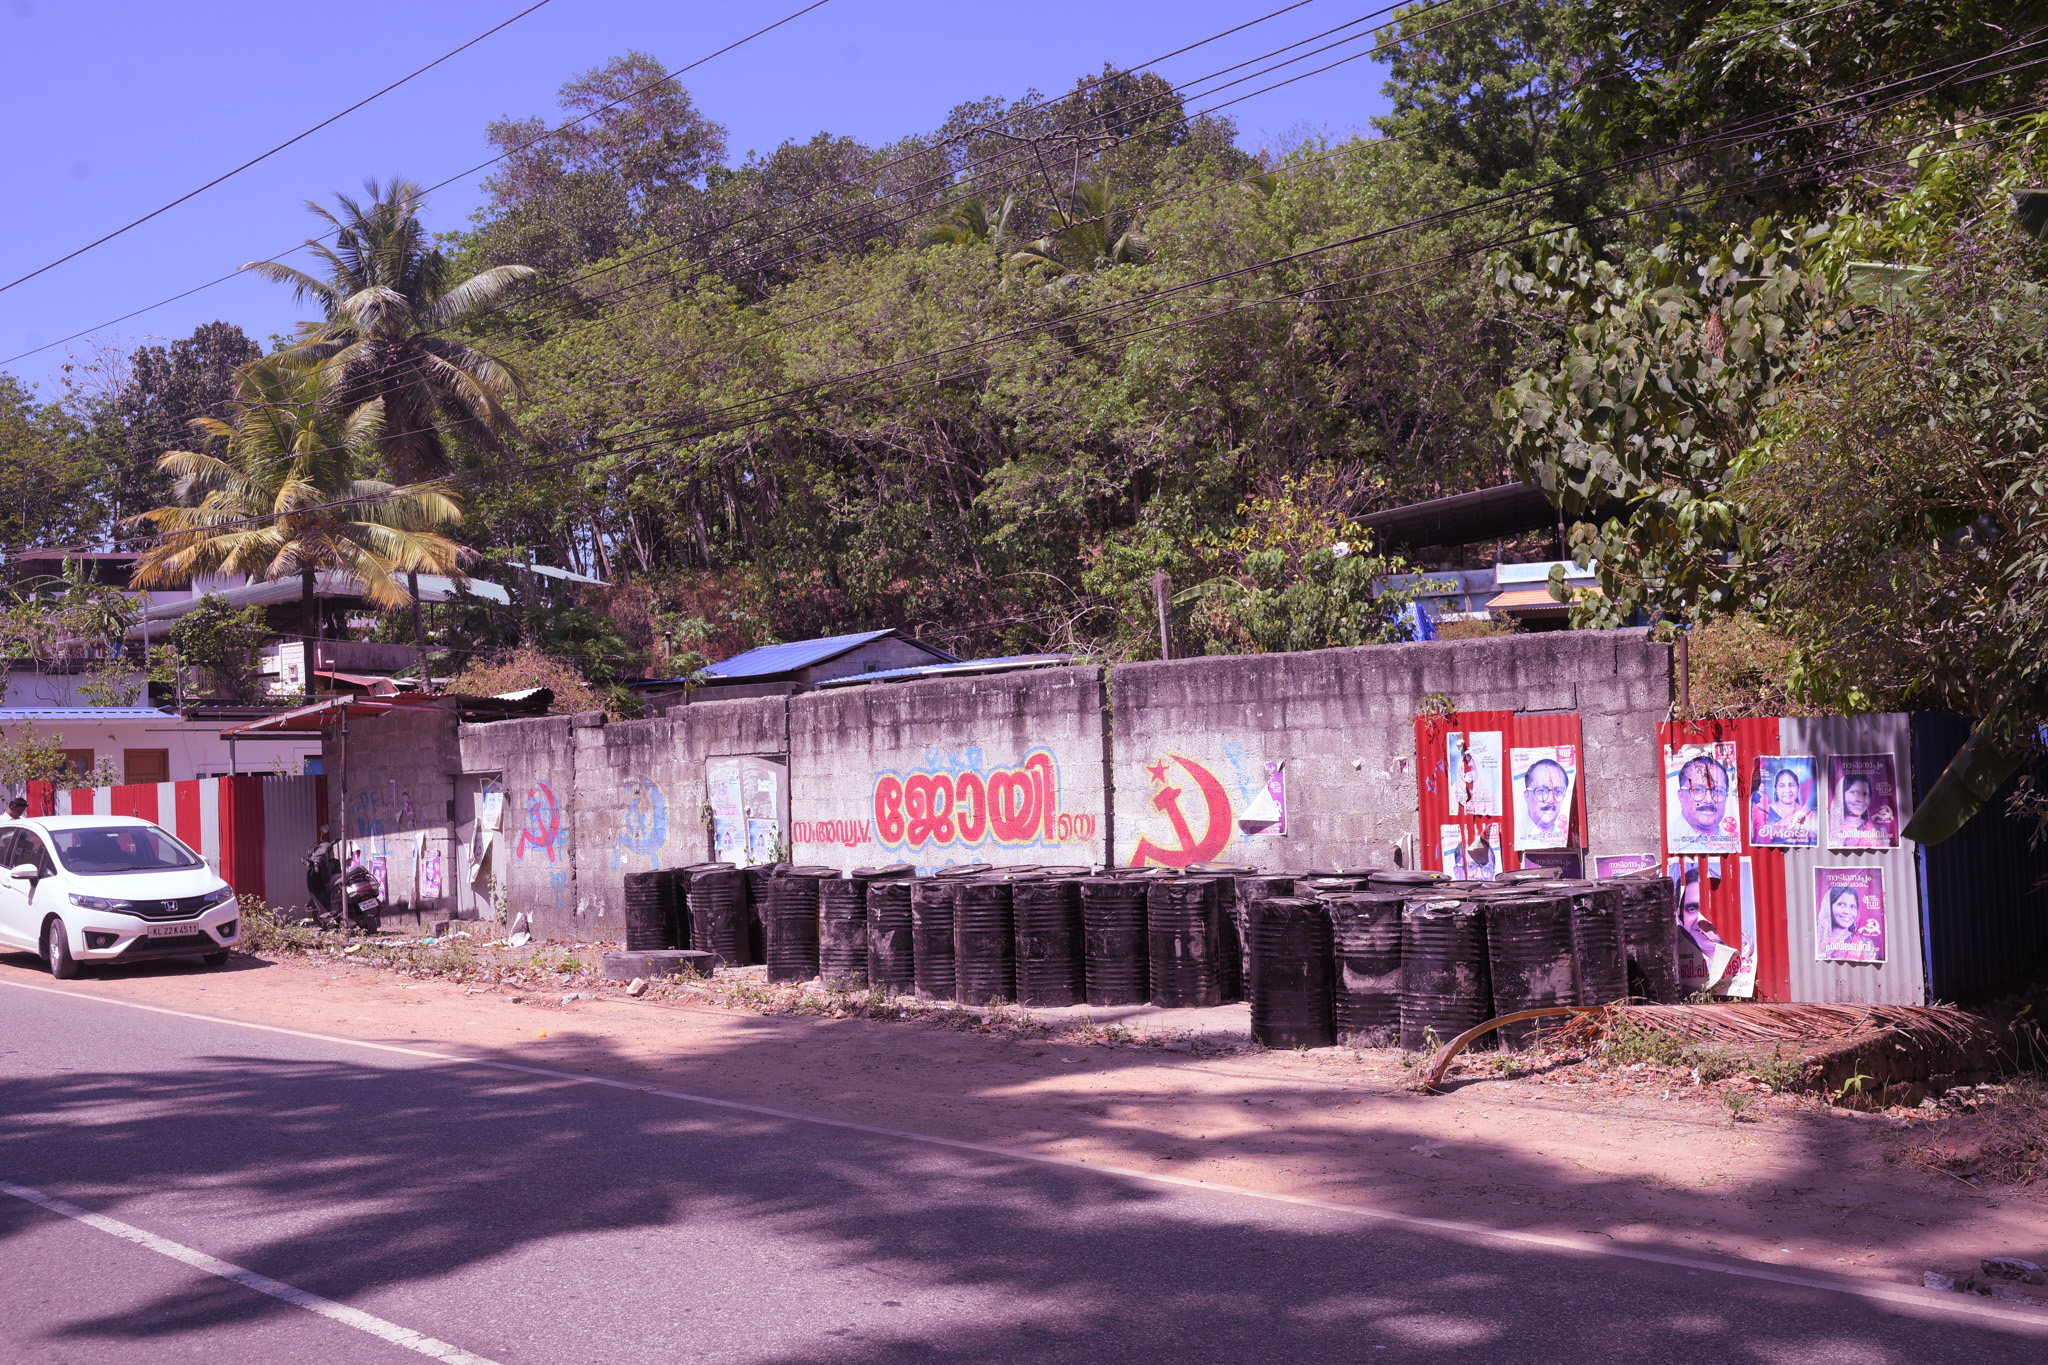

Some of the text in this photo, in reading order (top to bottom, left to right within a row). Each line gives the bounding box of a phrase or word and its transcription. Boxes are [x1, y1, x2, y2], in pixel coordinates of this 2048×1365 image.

[152, 927, 162, 936] KL
[163, 927, 173, 935] 22
[179, 925, 197, 934] 4511
